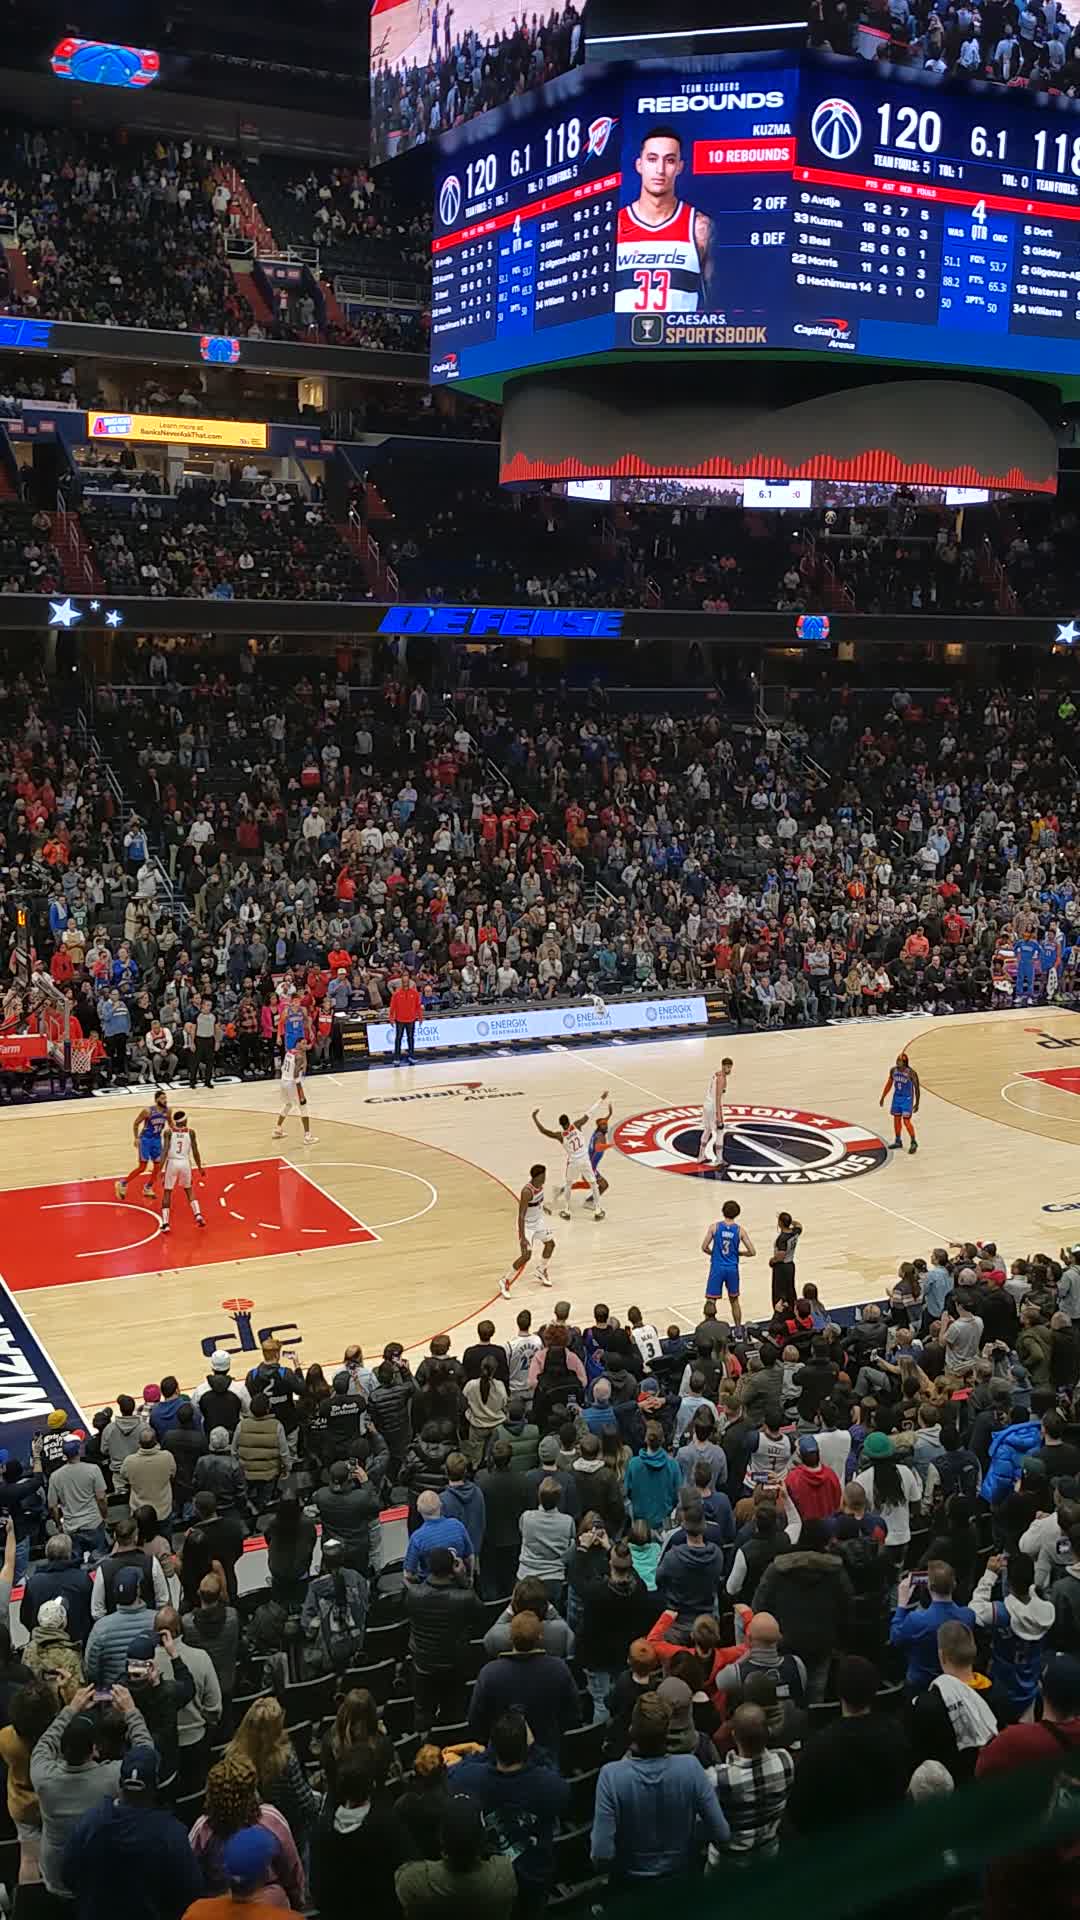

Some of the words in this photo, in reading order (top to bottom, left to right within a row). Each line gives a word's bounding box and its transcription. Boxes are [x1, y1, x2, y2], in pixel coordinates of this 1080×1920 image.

[681, 83, 701, 93] TEAM
[638, 92, 784, 114] REBOUNDS
[752, 124, 790, 136] KUZMA
[877, 103, 941, 153] 120
[971, 126, 1007, 160] 6.1
[466, 154, 496, 199] 120
[511, 144, 530, 177] 6.1
[545, 118, 580, 167] 118
[709, 150, 723, 163] 10
[726, 148, 789, 162] REBOUNDS
[874, 154, 894, 168] TEAM
[922, 161, 930, 173] 5
[959, 167, 963, 178] 1
[1021, 176, 1028, 188] 0
[594, 205, 599, 215] 2
[606, 201, 612, 211] 2
[753, 198, 761, 210] 2
[766, 197, 787, 209] OFF
[801, 193, 810, 203] 9
[864, 202, 877, 212] 12
[883, 205, 891, 215] 2
[900, 207, 908, 217] 7
[921, 210, 929, 220] 5
[972, 200, 986, 224] 4
[513, 215, 520, 237] 4
[794, 212, 808, 223] 33
[810, 216, 843, 228] Kuzma
[862, 223, 875, 232] 18
[882, 225, 890, 234] 9
[896, 227, 909, 237] 10
[920, 230, 928, 240] 3
[1024, 226, 1032, 235] 5
[1034, 227, 1052, 237] Dort
[750, 232, 759, 244] 8
[762, 232, 785, 244] DEF
[799, 234, 808, 244] 3
[809, 236, 830, 246] Beal
[860, 242, 875, 253] 25
[881, 244, 889, 254] 6
[897, 247, 906, 256] 6
[920, 250, 925, 259] 1
[1023, 246, 1030, 255] 3
[792, 253, 806, 264] 22
[808, 256, 838, 267] Morris
[861, 262, 871, 272] 11
[879, 265, 888, 274] 4
[896, 266, 904, 276] 3
[917, 269, 925, 279] 3
[944, 256, 960, 267] 51.1
[990, 262, 1007, 272] 53.7
[1022, 266, 1029, 274] 2
[634, 270, 671, 311] 33
[797, 274, 805, 284] 8
[807, 276, 857, 290] Hachimura
[859, 282, 872, 292] 14
[878, 284, 887, 294] 2
[896, 286, 902, 295] 1
[915, 288, 925, 298] 0
[1016, 285, 1028, 294] 12
[941, 299, 951, 308] 50
[987, 303, 997, 313] 50
[1013, 304, 1026, 313] 34
[666, 314, 725, 326] CAESARS
[666, 326, 767, 344] SPORTSBOOK
[828, 339, 855, 350] Arena
[140, 428, 222, 440] BanksNeverAskThat.com
[378, 606, 625, 638] DEFENSE
[659, 1005, 692, 1014] ENERGIX
[490, 1018, 528, 1029] ENERGIX
[91, 1076, 242, 1097] GEICO
[464, 1090, 525, 1101] Arena
[176, 1141, 183, 1154] 3
[569, 1136, 583, 1152] 22
[726, 1154, 876, 1184] WIZARDS
[722, 1240, 730, 1255] 3
[646, 1342, 655, 1359] 3
